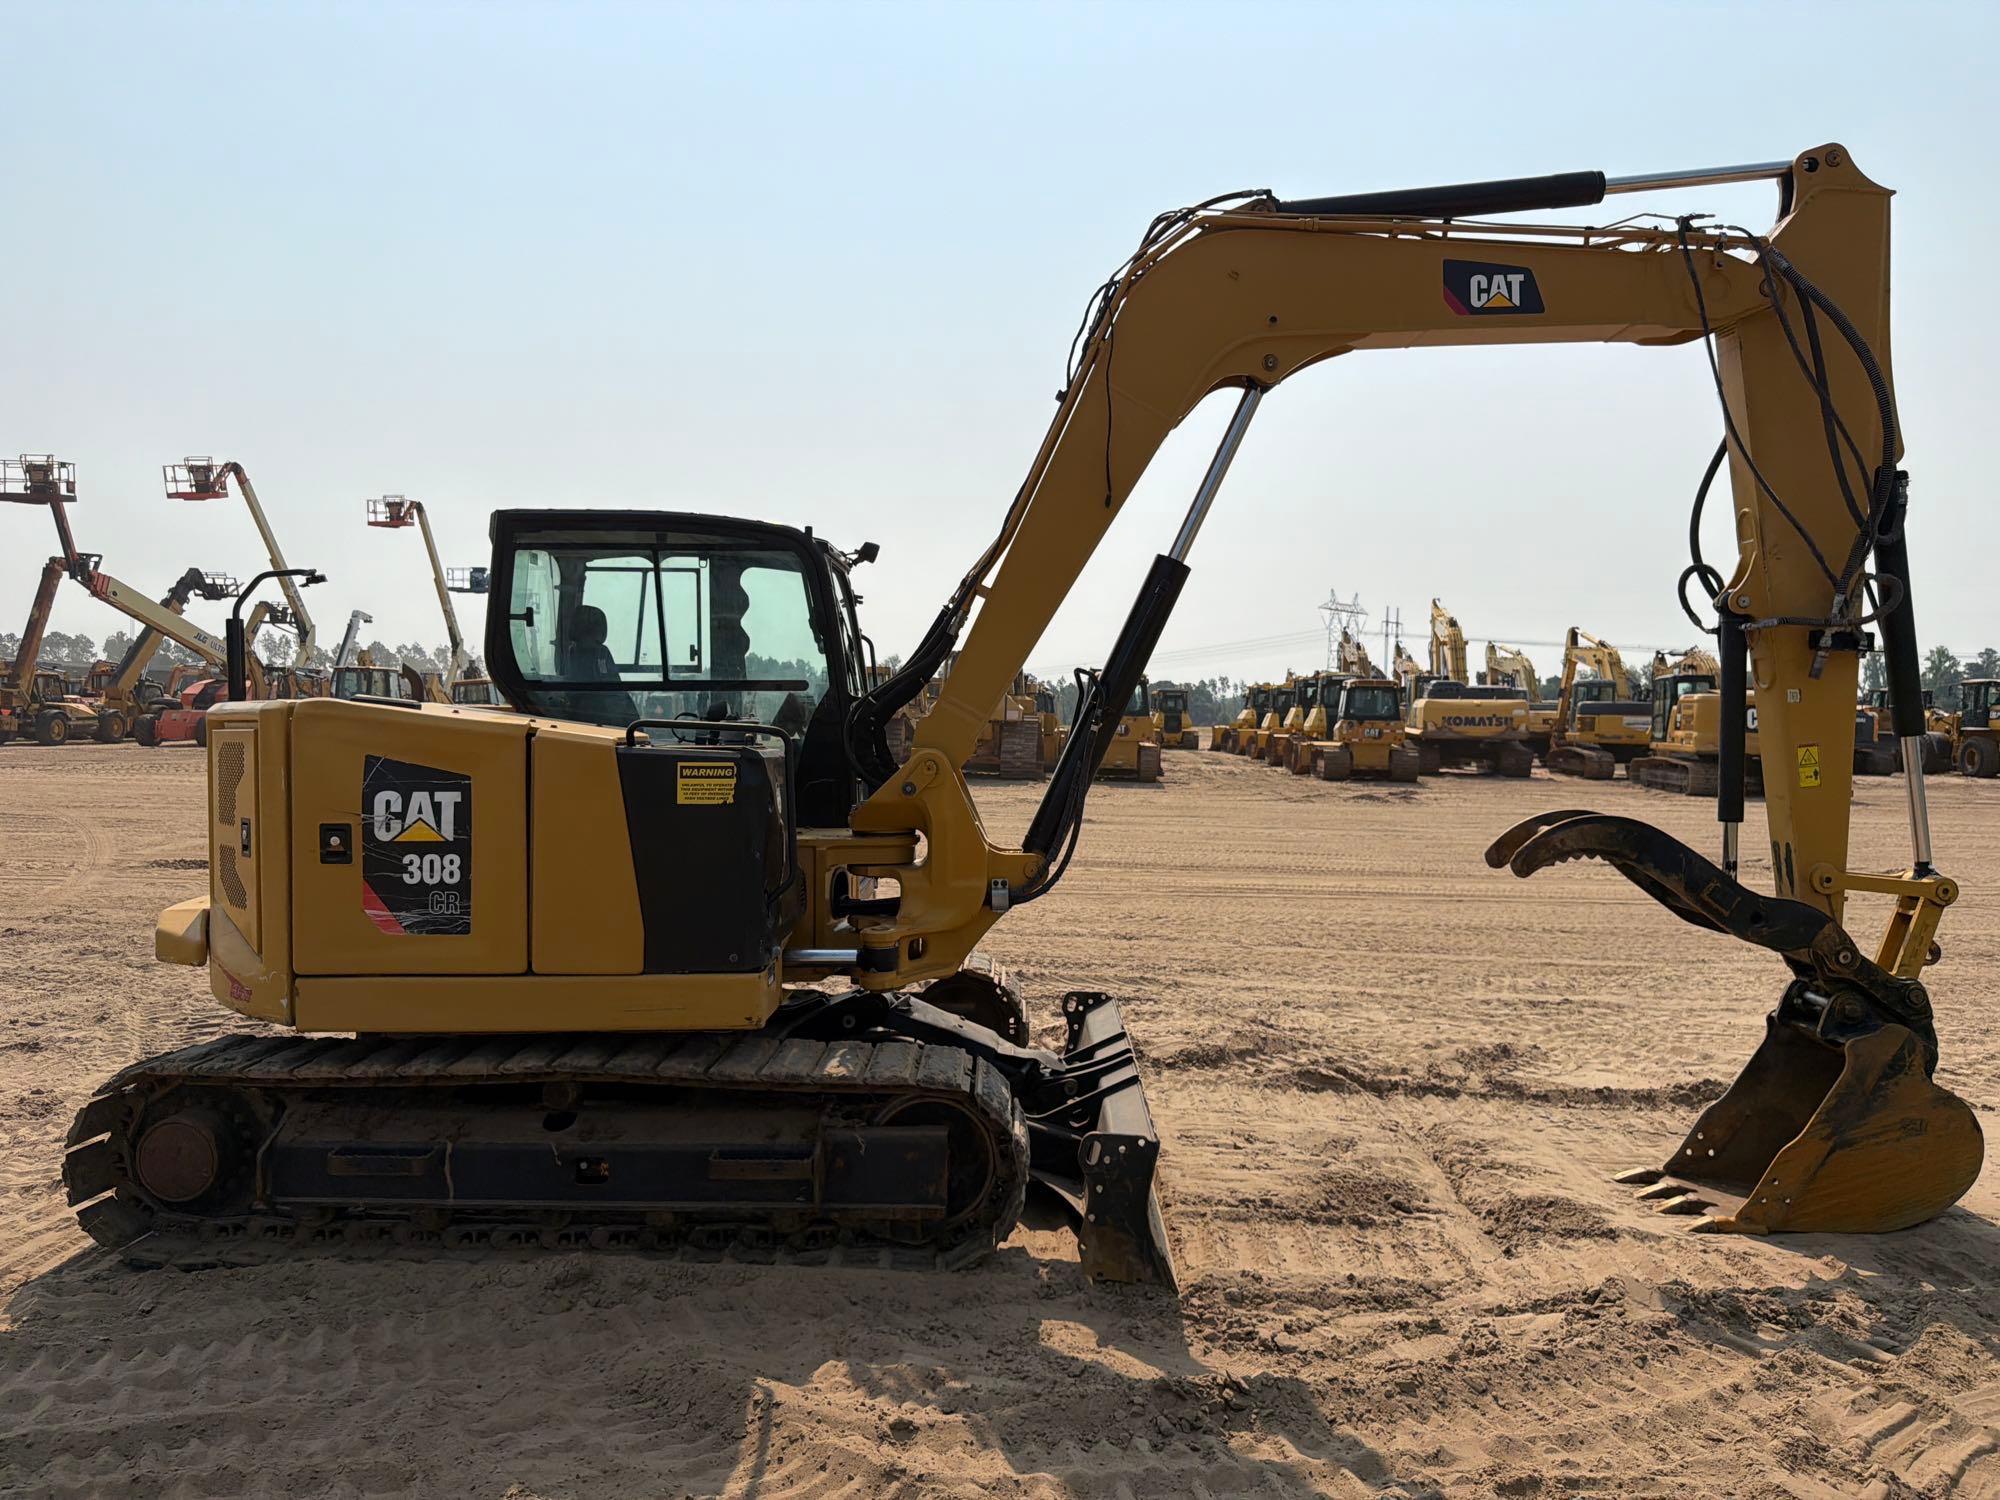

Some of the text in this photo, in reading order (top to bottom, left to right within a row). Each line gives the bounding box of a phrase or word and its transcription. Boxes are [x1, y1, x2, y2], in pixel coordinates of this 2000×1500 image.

[1470, 274, 1525, 308] CAT
[193, 632, 227, 656] JLG ULTR
[682, 768, 733, 776] WARNING
[373, 790, 462, 842] CAT
[402, 854, 461, 885] 308
[429, 891, 460, 915] CR
